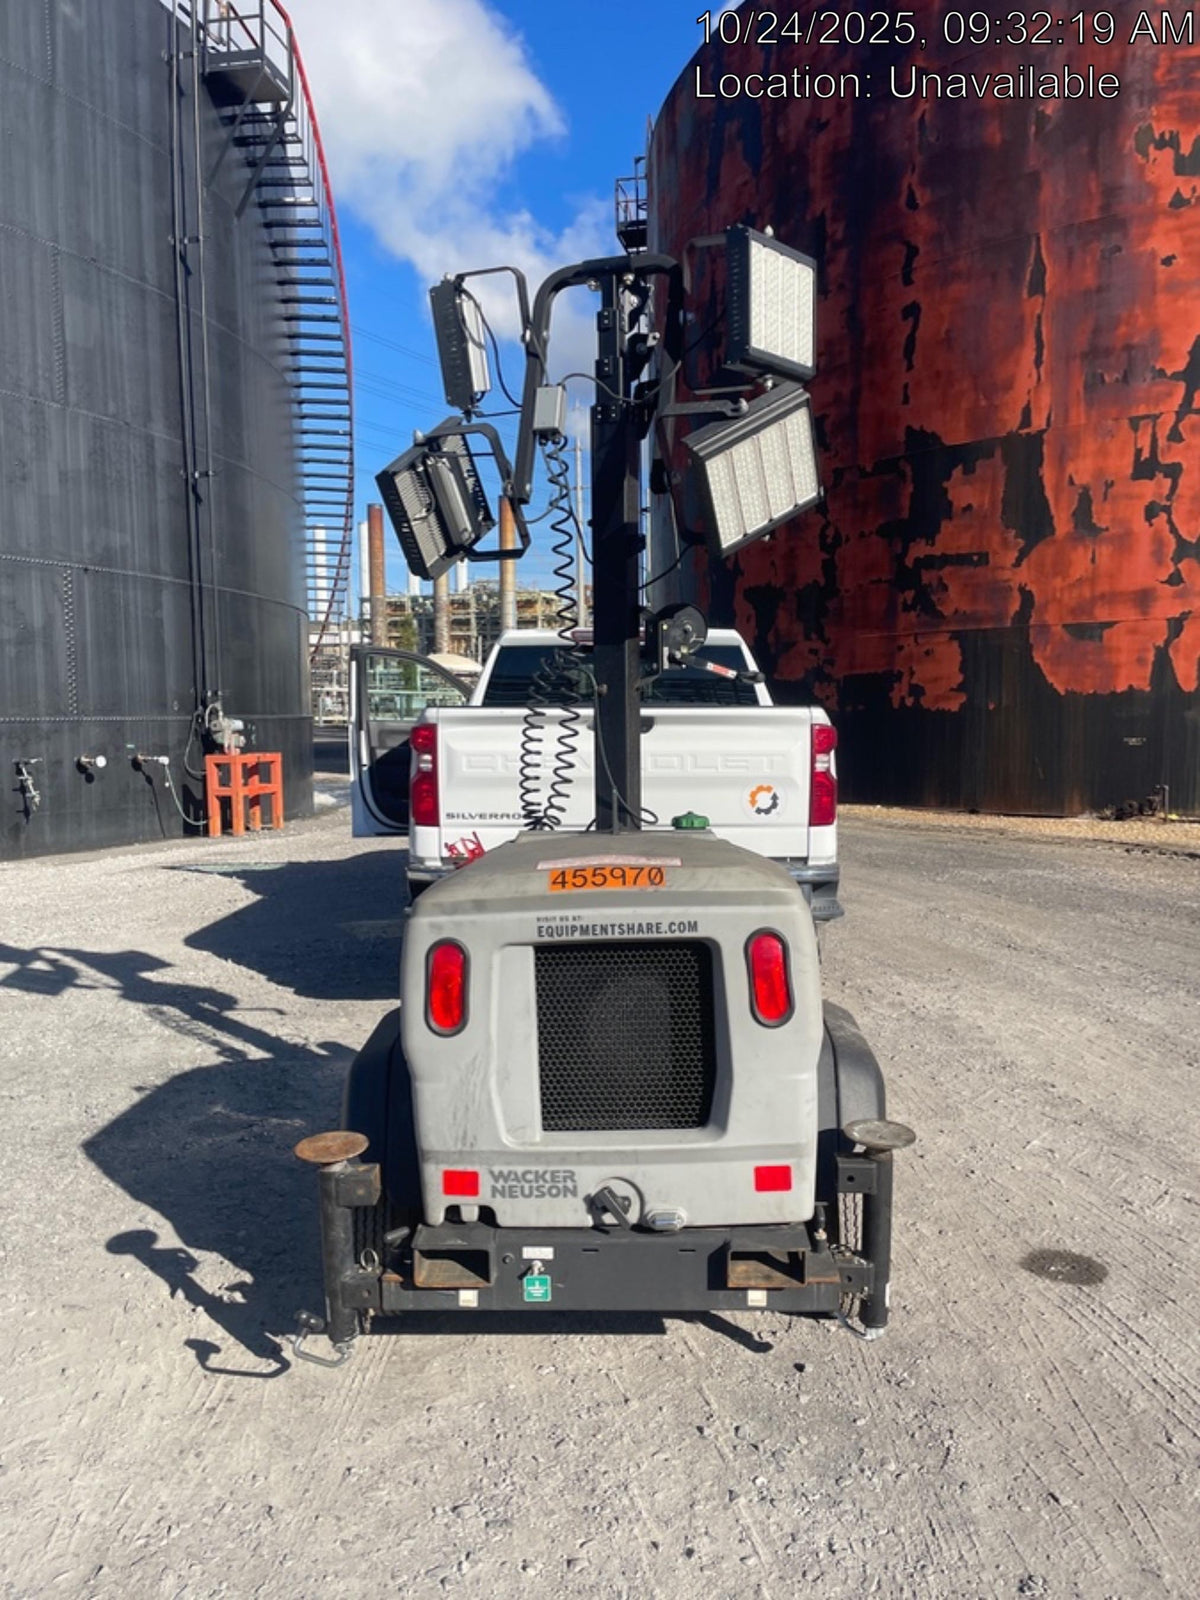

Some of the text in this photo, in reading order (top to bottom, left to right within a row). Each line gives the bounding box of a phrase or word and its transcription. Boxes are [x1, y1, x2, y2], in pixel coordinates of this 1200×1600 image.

[461, 751, 787, 773] CHEOLET
[445, 812, 526, 821] SILVERAD
[551, 866, 664, 889] 455970
[536, 920, 698, 938] EQUIPMENTSHARE.COM
[488, 1169, 576, 1184] WACKER
[490, 1184, 578, 1199] NEUSON
